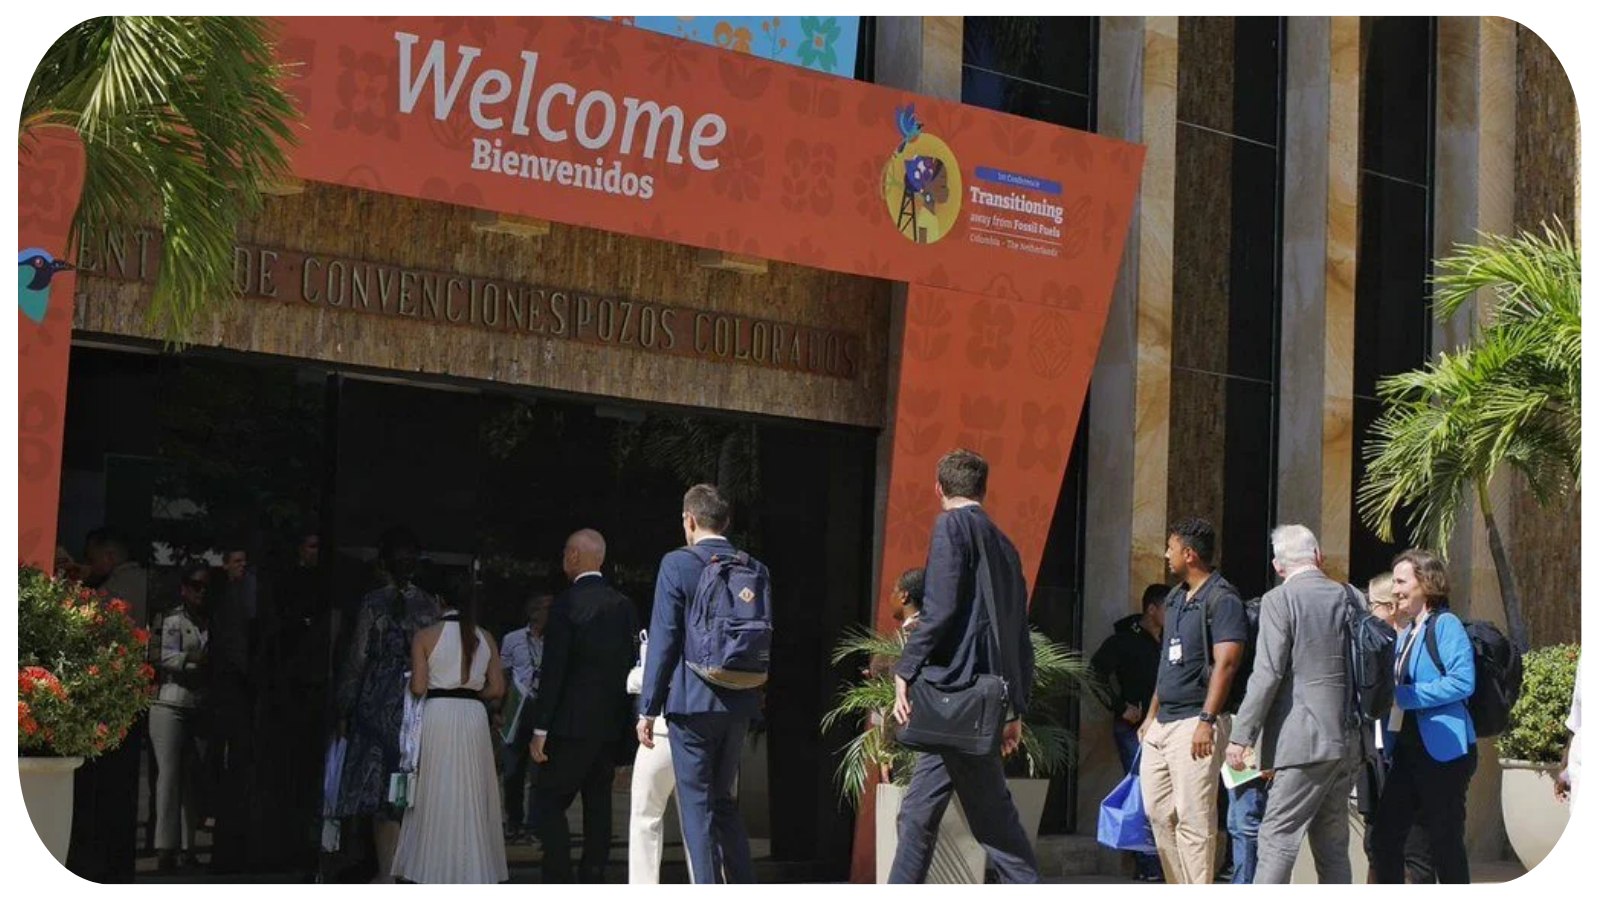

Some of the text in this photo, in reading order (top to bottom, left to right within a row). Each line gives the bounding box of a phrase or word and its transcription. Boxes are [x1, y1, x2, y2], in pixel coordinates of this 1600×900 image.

[395, 31, 727, 171] Welcome
[470, 138, 655, 200] Bienvenidos
[970, 186, 1063, 224] Transitioning
[970, 214, 1060, 238] away from Fossil Fuels
[970, 233, 1000, 247] Colombia
[234, 246, 279, 297] DE
[302, 256, 567, 335] CONVENCIONES
[577, 295, 677, 349] POZOS
[694, 311, 858, 379] COLORADOS
